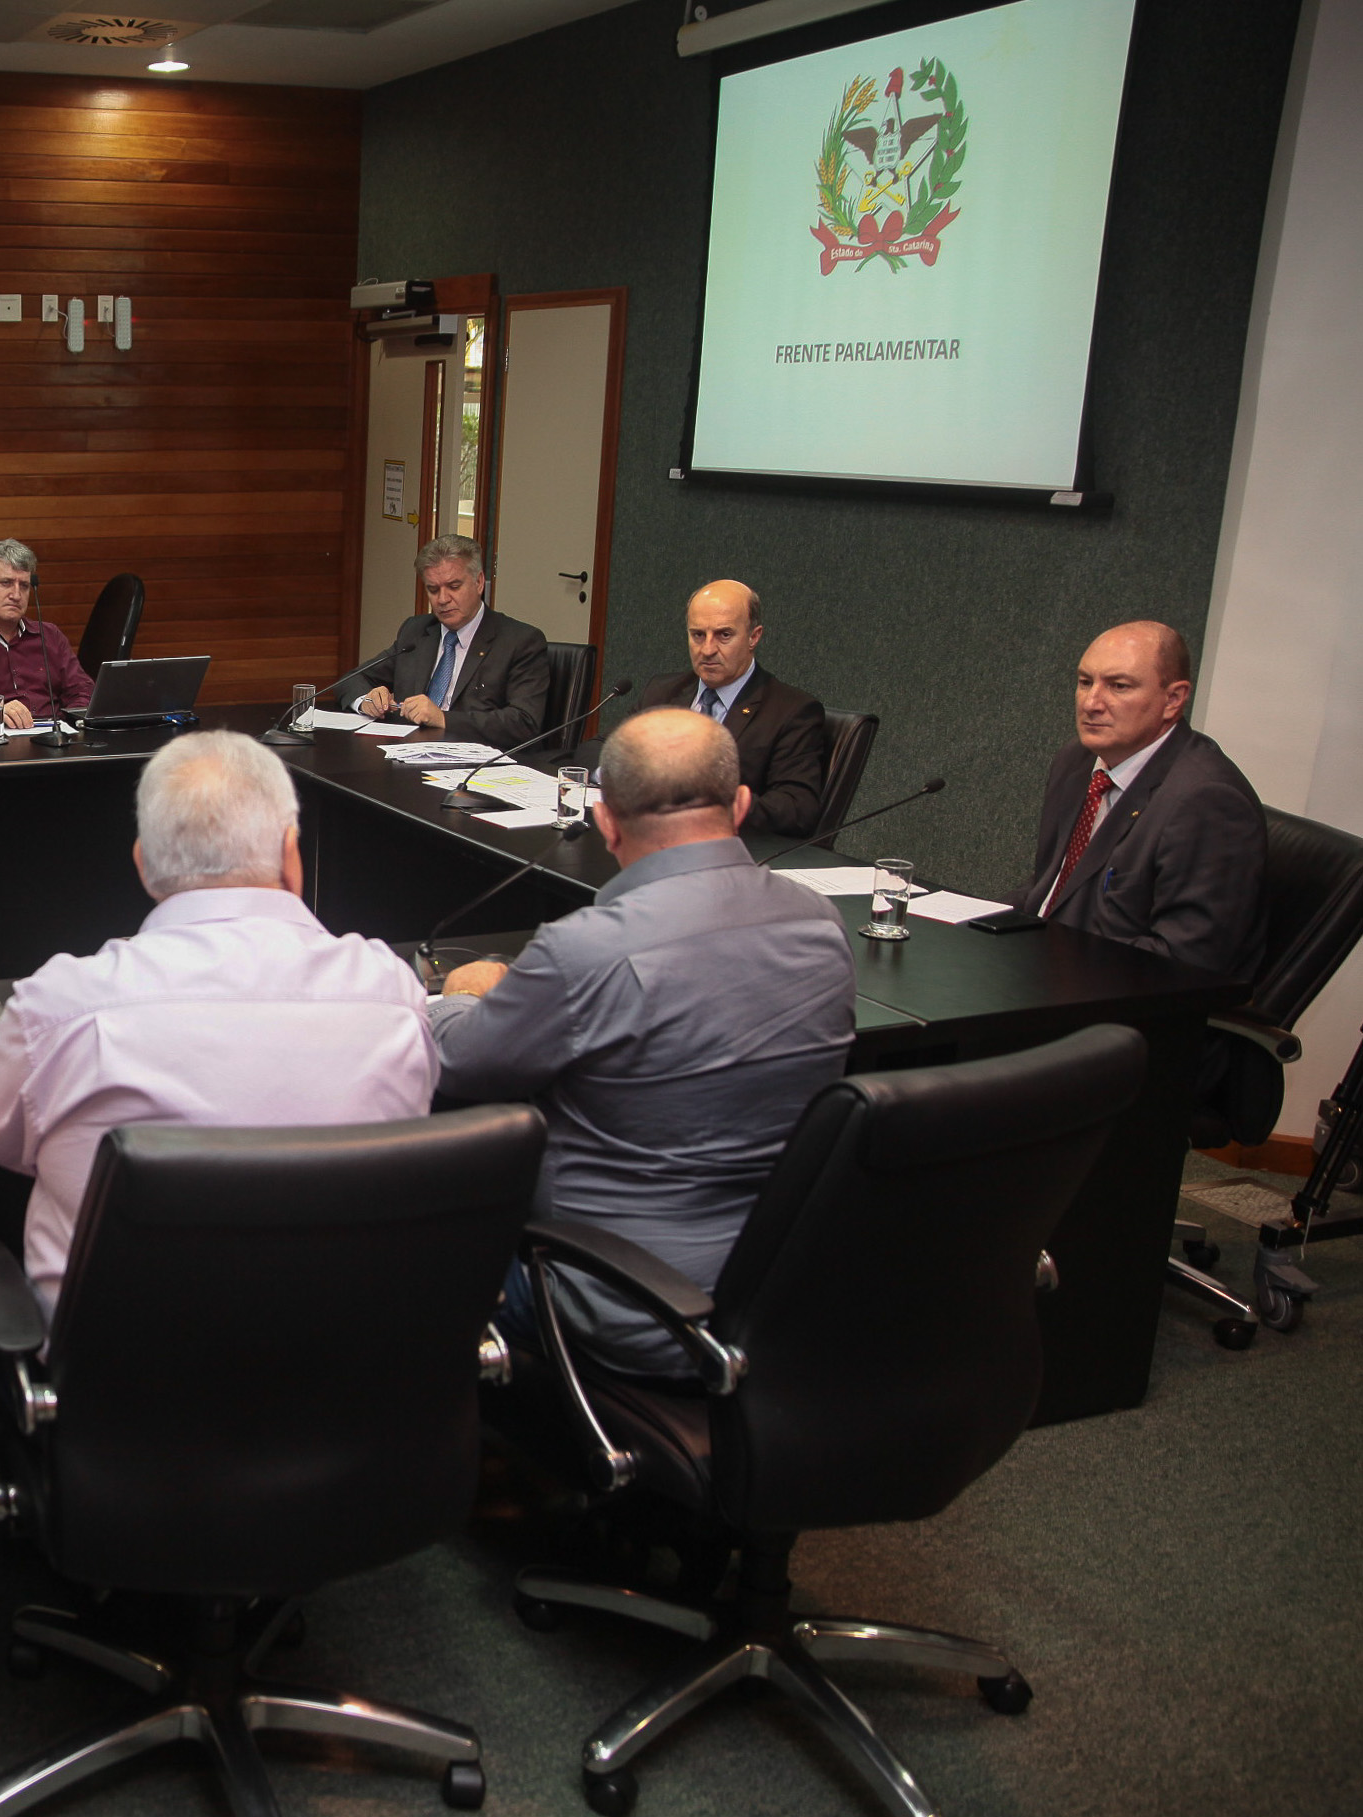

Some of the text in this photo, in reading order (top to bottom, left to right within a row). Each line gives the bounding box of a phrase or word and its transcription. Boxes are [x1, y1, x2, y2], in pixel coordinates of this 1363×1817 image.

[831, 247, 854, 260] Estado
[903, 239, 935, 253] Catarina
[775, 338, 961, 364] FRENTE PARLAMENTAR
